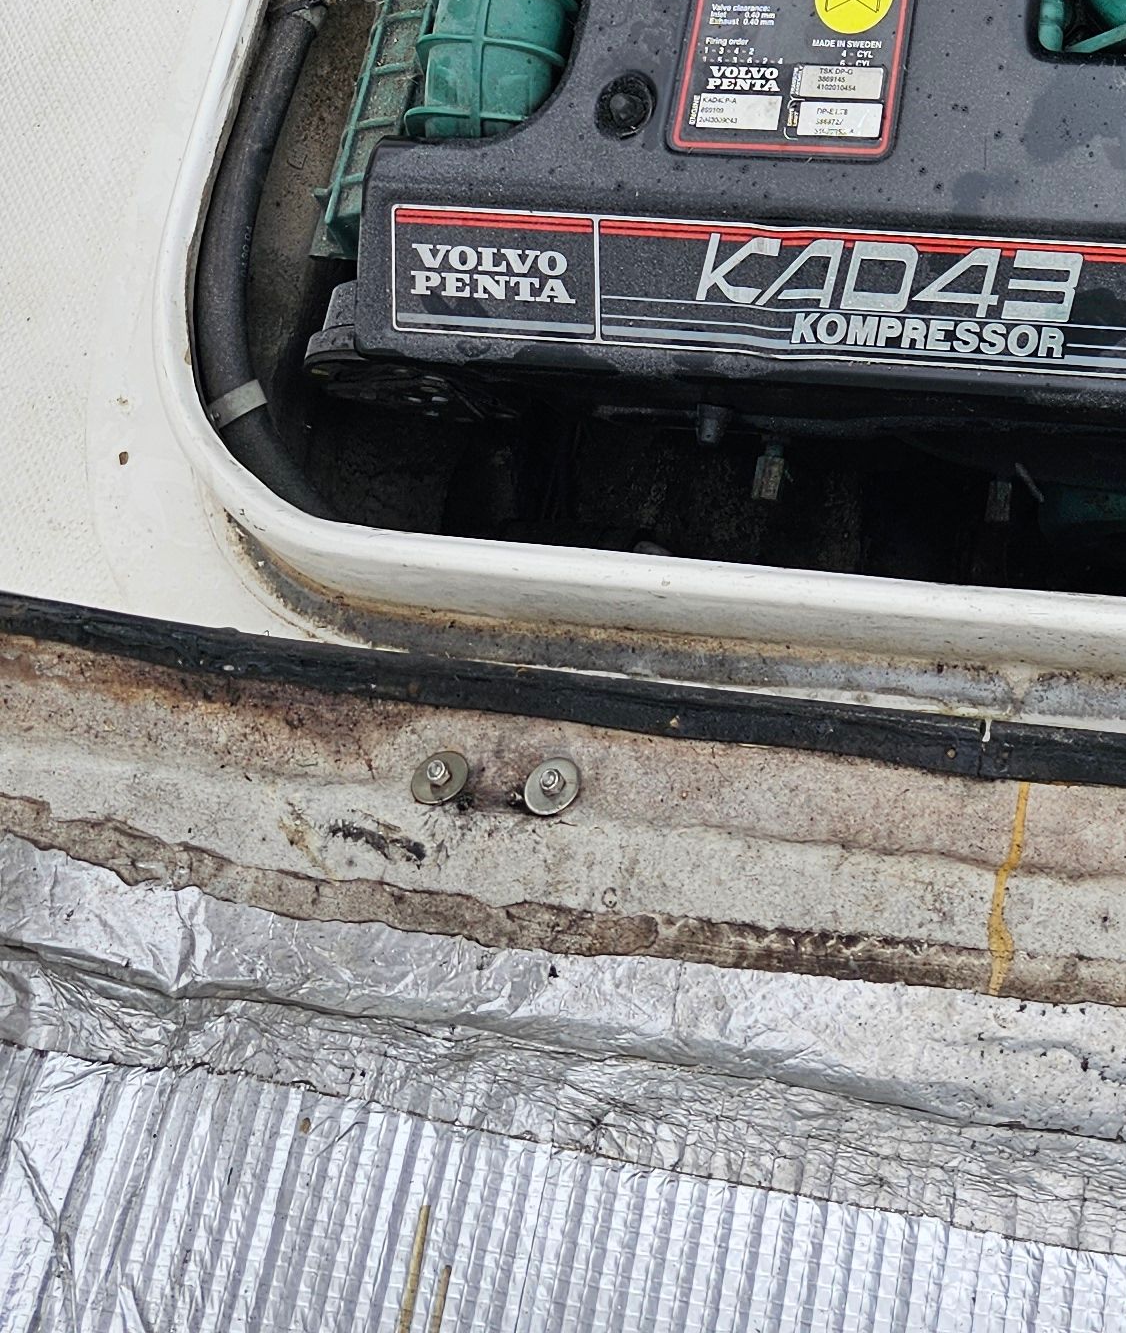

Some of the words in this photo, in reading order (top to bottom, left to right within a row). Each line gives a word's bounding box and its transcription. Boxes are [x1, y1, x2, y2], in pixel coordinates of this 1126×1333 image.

[732, 4, 771, 12] clearance:
[709, 17, 740, 25] Exhaust
[744, 11, 760, 19] 0.40
[705, 36, 728, 46] Firing
[812, 39, 836, 47] MADE
[836, 40, 846, 48] IN
[846, 40, 882, 49] SWEDEN
[856, 50, 873, 58] CYL
[709, 65, 779, 79] VOLVO
[706, 77, 780, 92] PENTA
[411, 243, 568, 277] VOLVO
[696, 233, 1084, 323] KAD43
[410, 270, 576, 304] PENTA
[790, 312, 1065, 359] KOMPRESSOR
